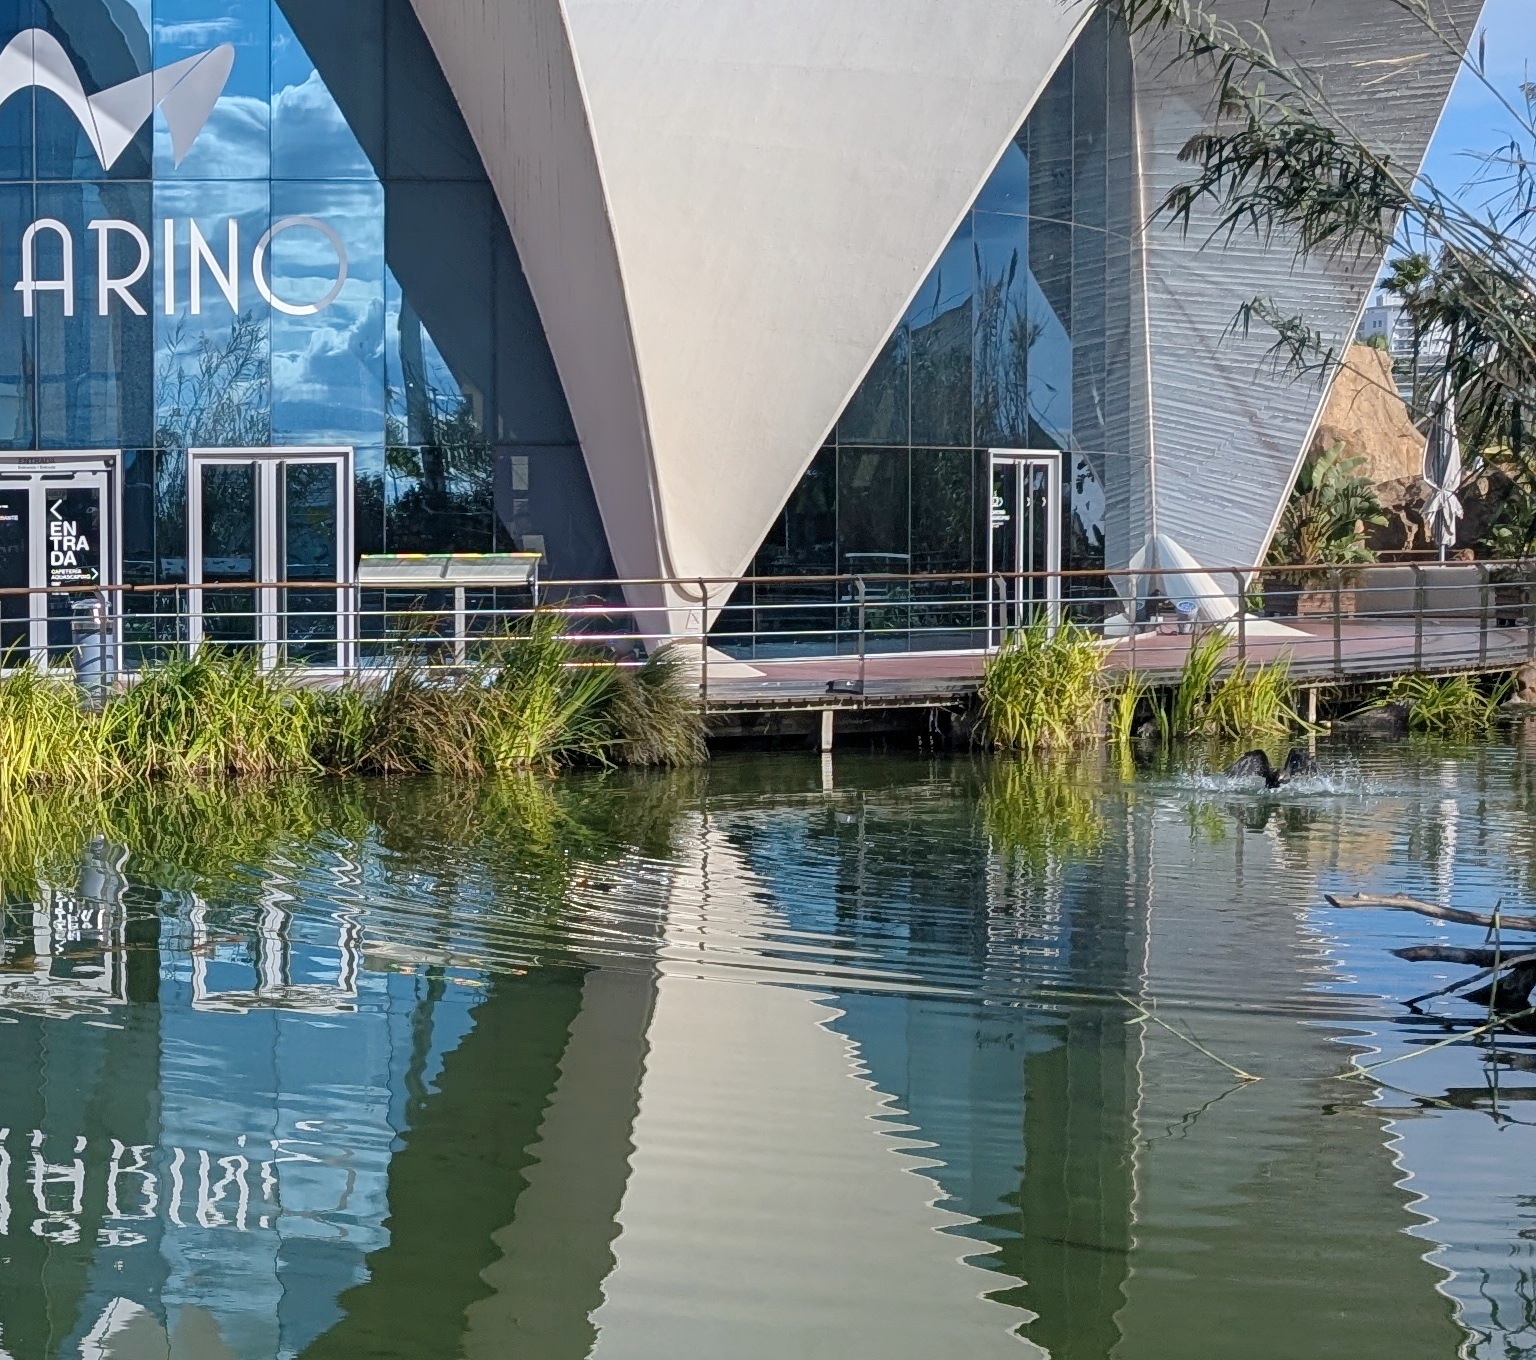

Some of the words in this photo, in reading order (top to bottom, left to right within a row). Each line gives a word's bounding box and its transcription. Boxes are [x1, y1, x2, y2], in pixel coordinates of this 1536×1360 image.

[50, 520, 77, 536] EN
[49, 535, 90, 551] TRA
[50, 550, 78, 566] DA
